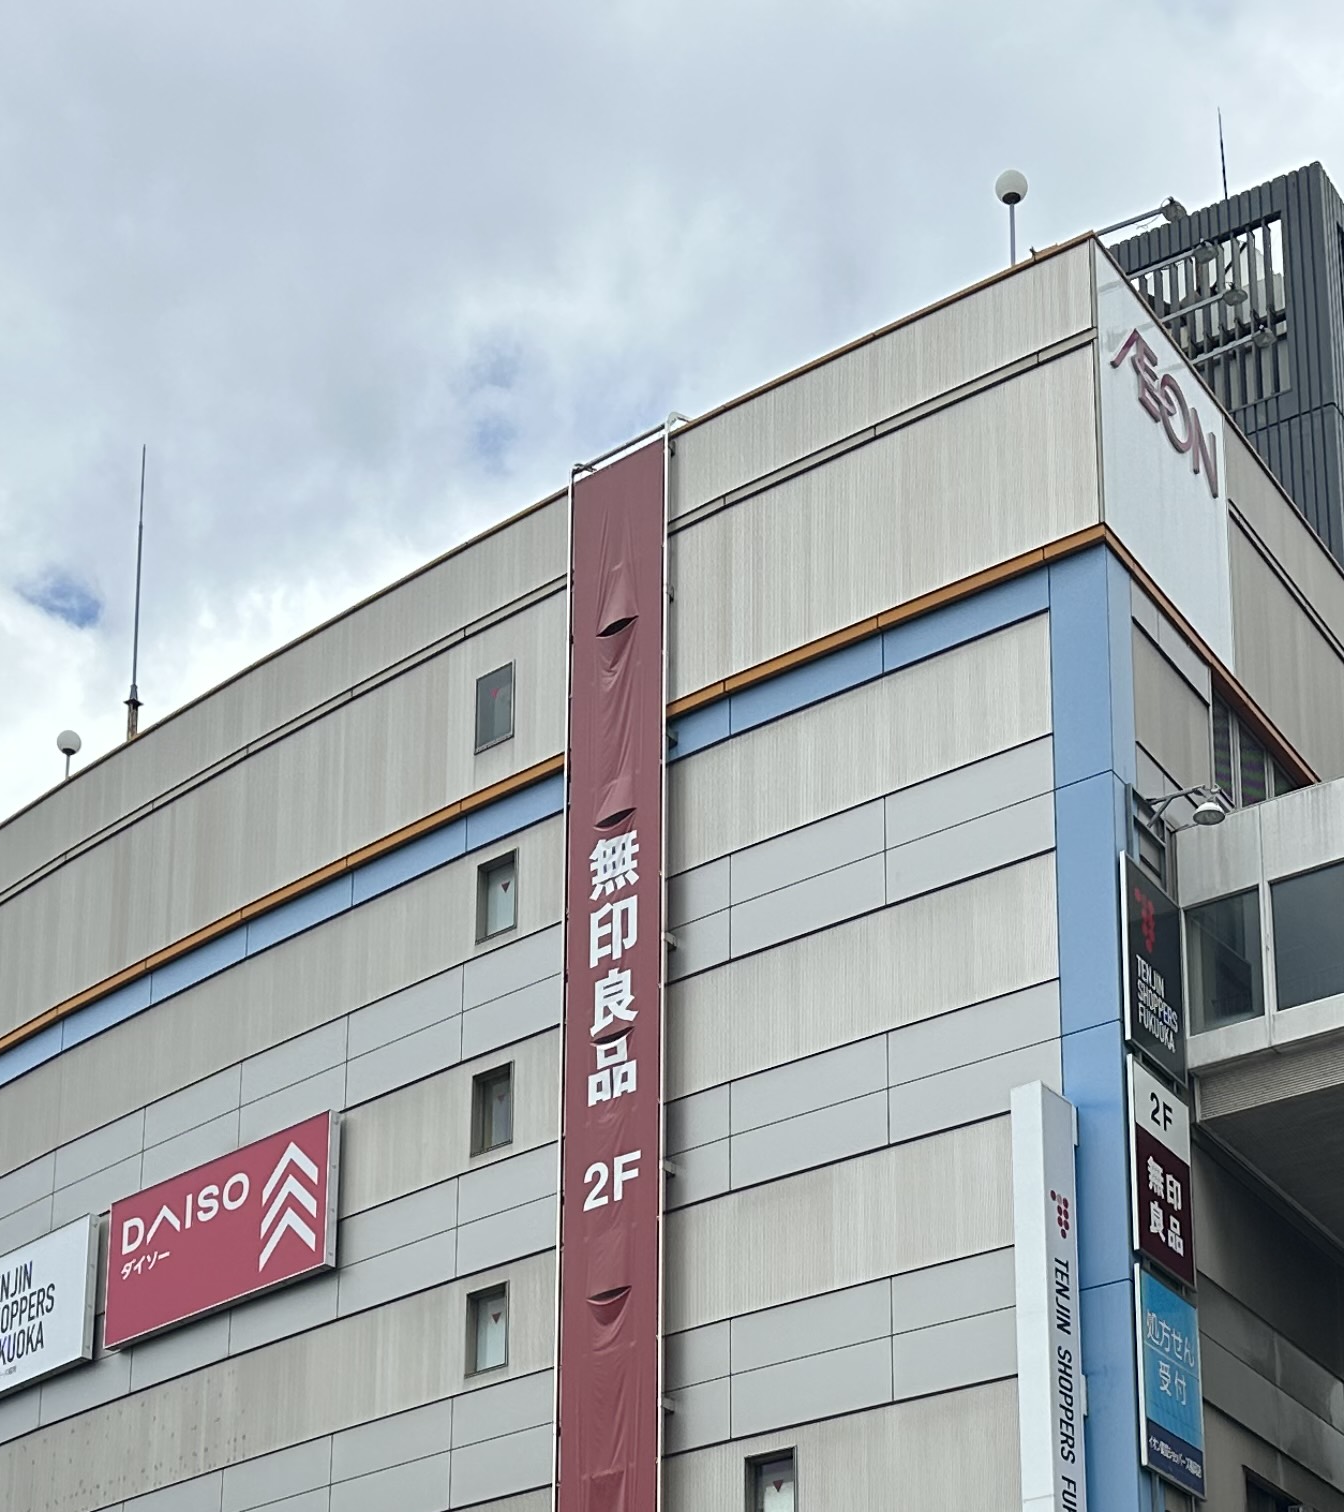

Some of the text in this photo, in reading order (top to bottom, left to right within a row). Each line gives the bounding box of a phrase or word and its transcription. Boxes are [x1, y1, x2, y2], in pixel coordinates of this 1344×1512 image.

[587, 829, 641, 1107] 無印良品
[1136, 953, 1165, 999] TENJIN
[1137, 978, 1178, 1033] SHOPPERS
[1138, 1002, 1176, 1053] FUKUOKA
[1150, 1092, 1174, 1132] 2F
[582, 1150, 642, 1213] 2F
[1147, 1155, 1182, 1212] 無印
[121, 1172, 250, 1256] DAISO
[1149, 1200, 1185, 1258] 良品
[120, 1250, 171, 1280] ダイソー
[1054, 1256, 1072, 1336] TENJIN
[1146, 1309, 1195, 1368] 処方せん
[1057, 1345, 1076, 1465] SHOPPERS
[1159, 1360, 1187, 1406] 受付
